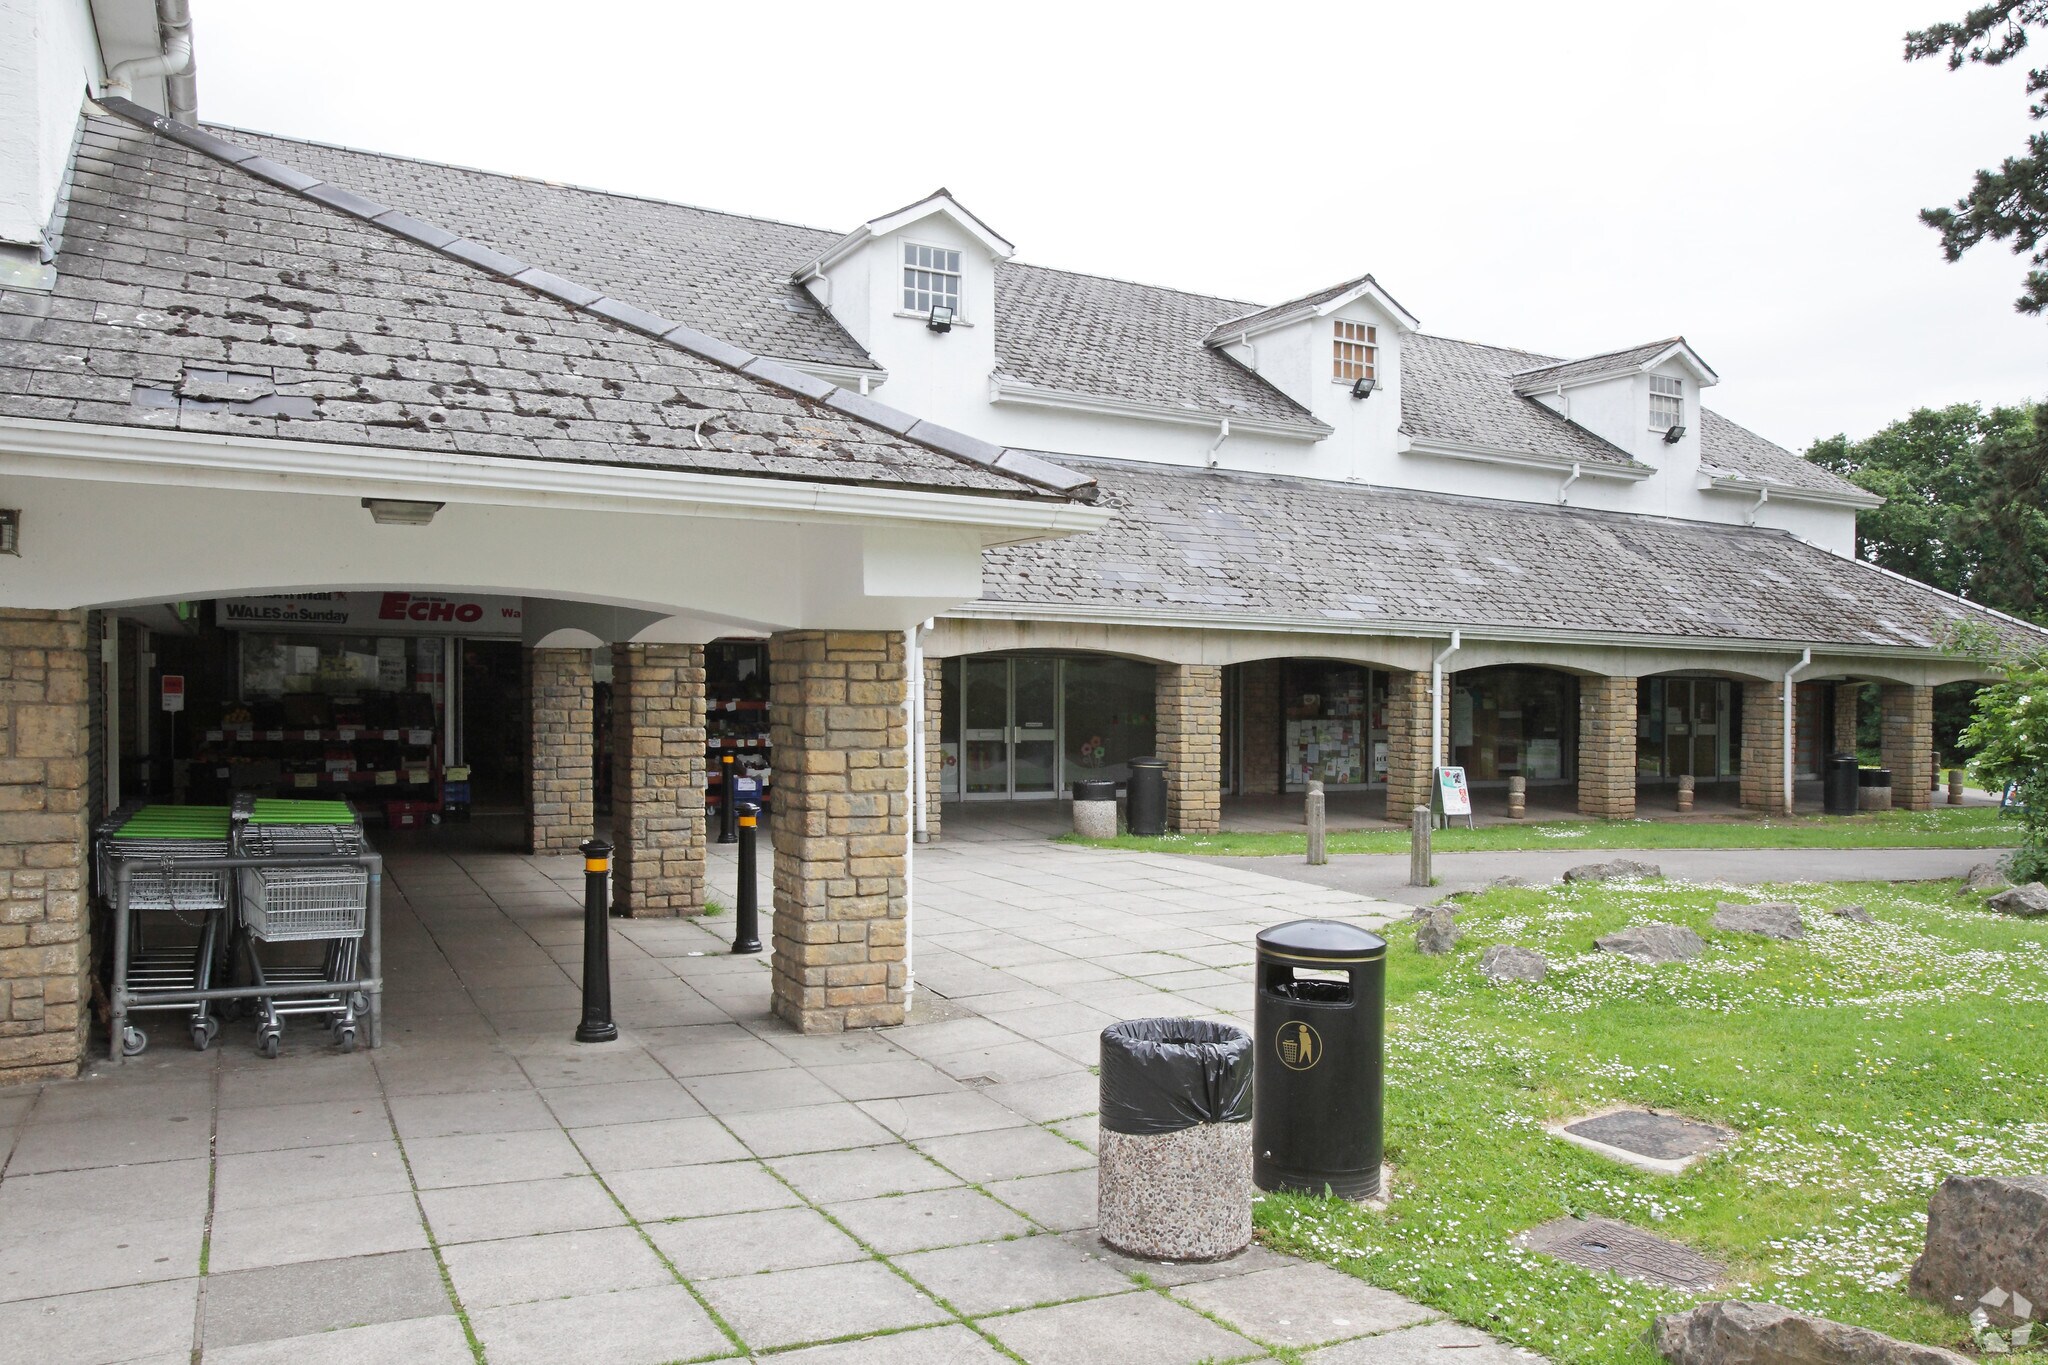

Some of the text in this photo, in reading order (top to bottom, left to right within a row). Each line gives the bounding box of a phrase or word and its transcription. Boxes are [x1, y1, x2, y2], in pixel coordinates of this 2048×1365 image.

[227, 604, 349, 624] WALES on Sunday
[378, 592, 483, 622] ECHO
[502, 608, 521, 618] Wa
